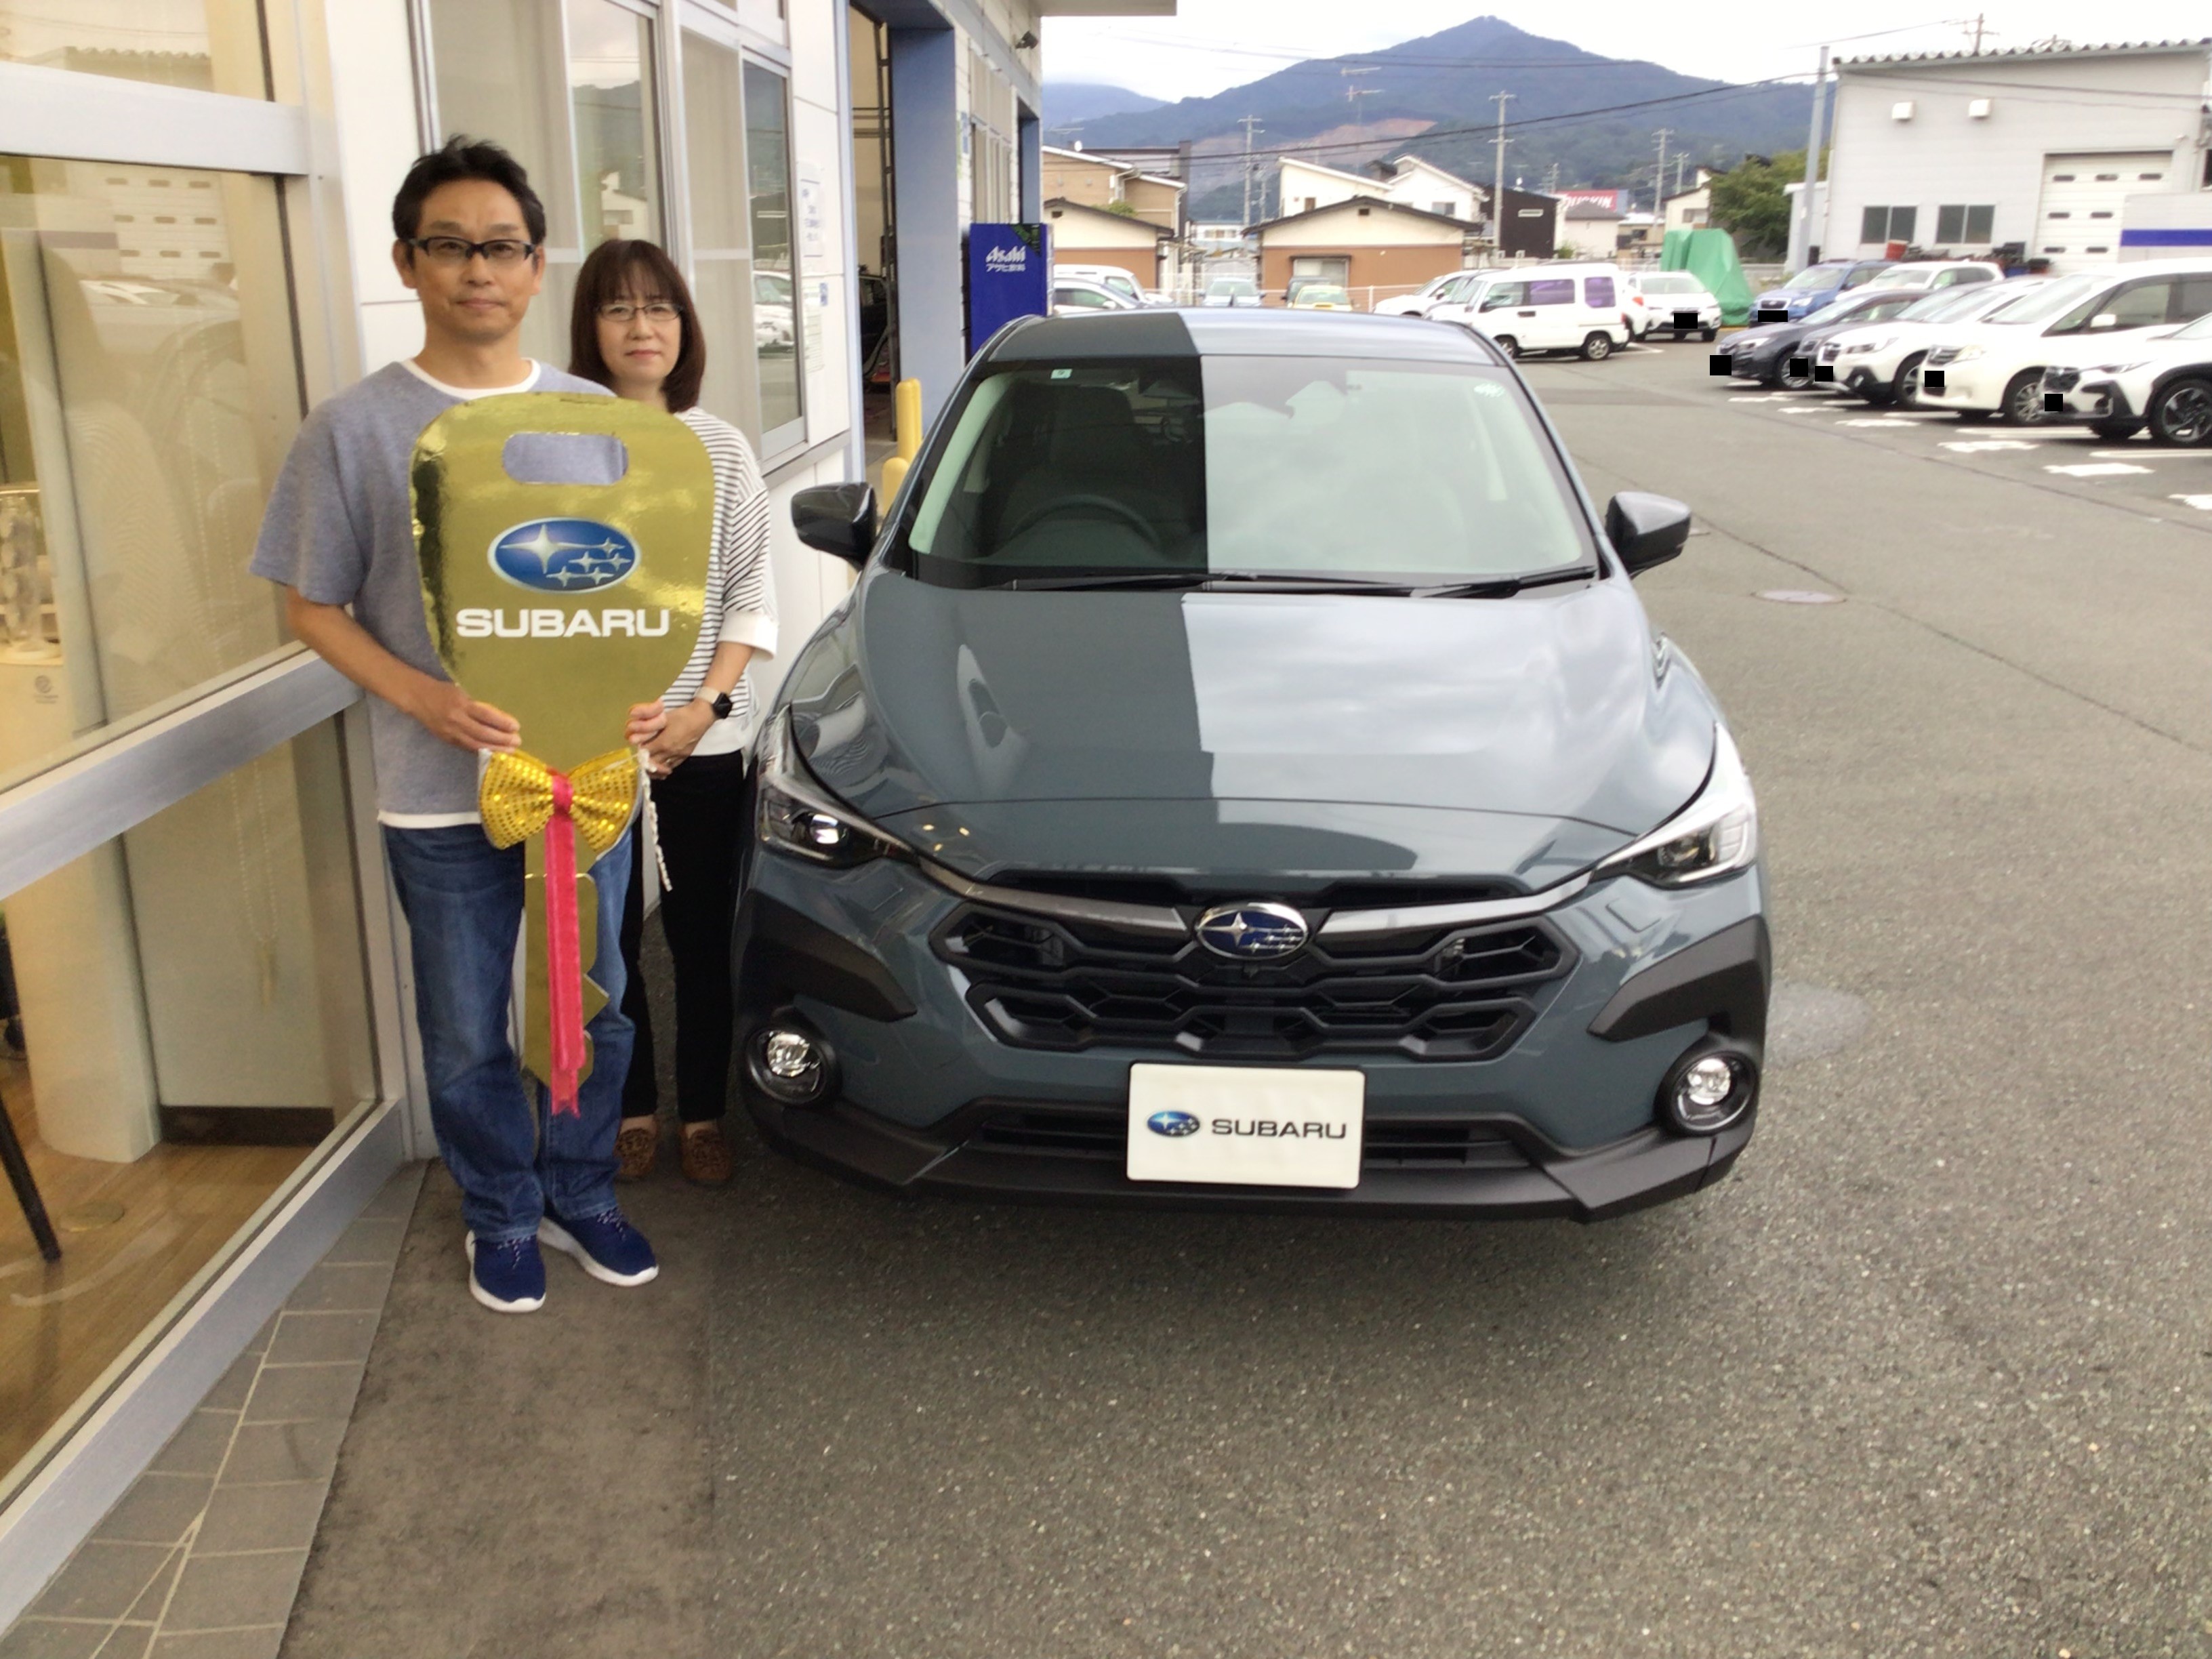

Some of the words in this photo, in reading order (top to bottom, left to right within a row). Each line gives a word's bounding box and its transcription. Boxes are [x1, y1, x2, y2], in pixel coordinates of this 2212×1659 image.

[985, 245, 1027, 263] Asahi
[456, 608, 670, 638] SUBARU
[1212, 1118, 1347, 1139] SUBARU
